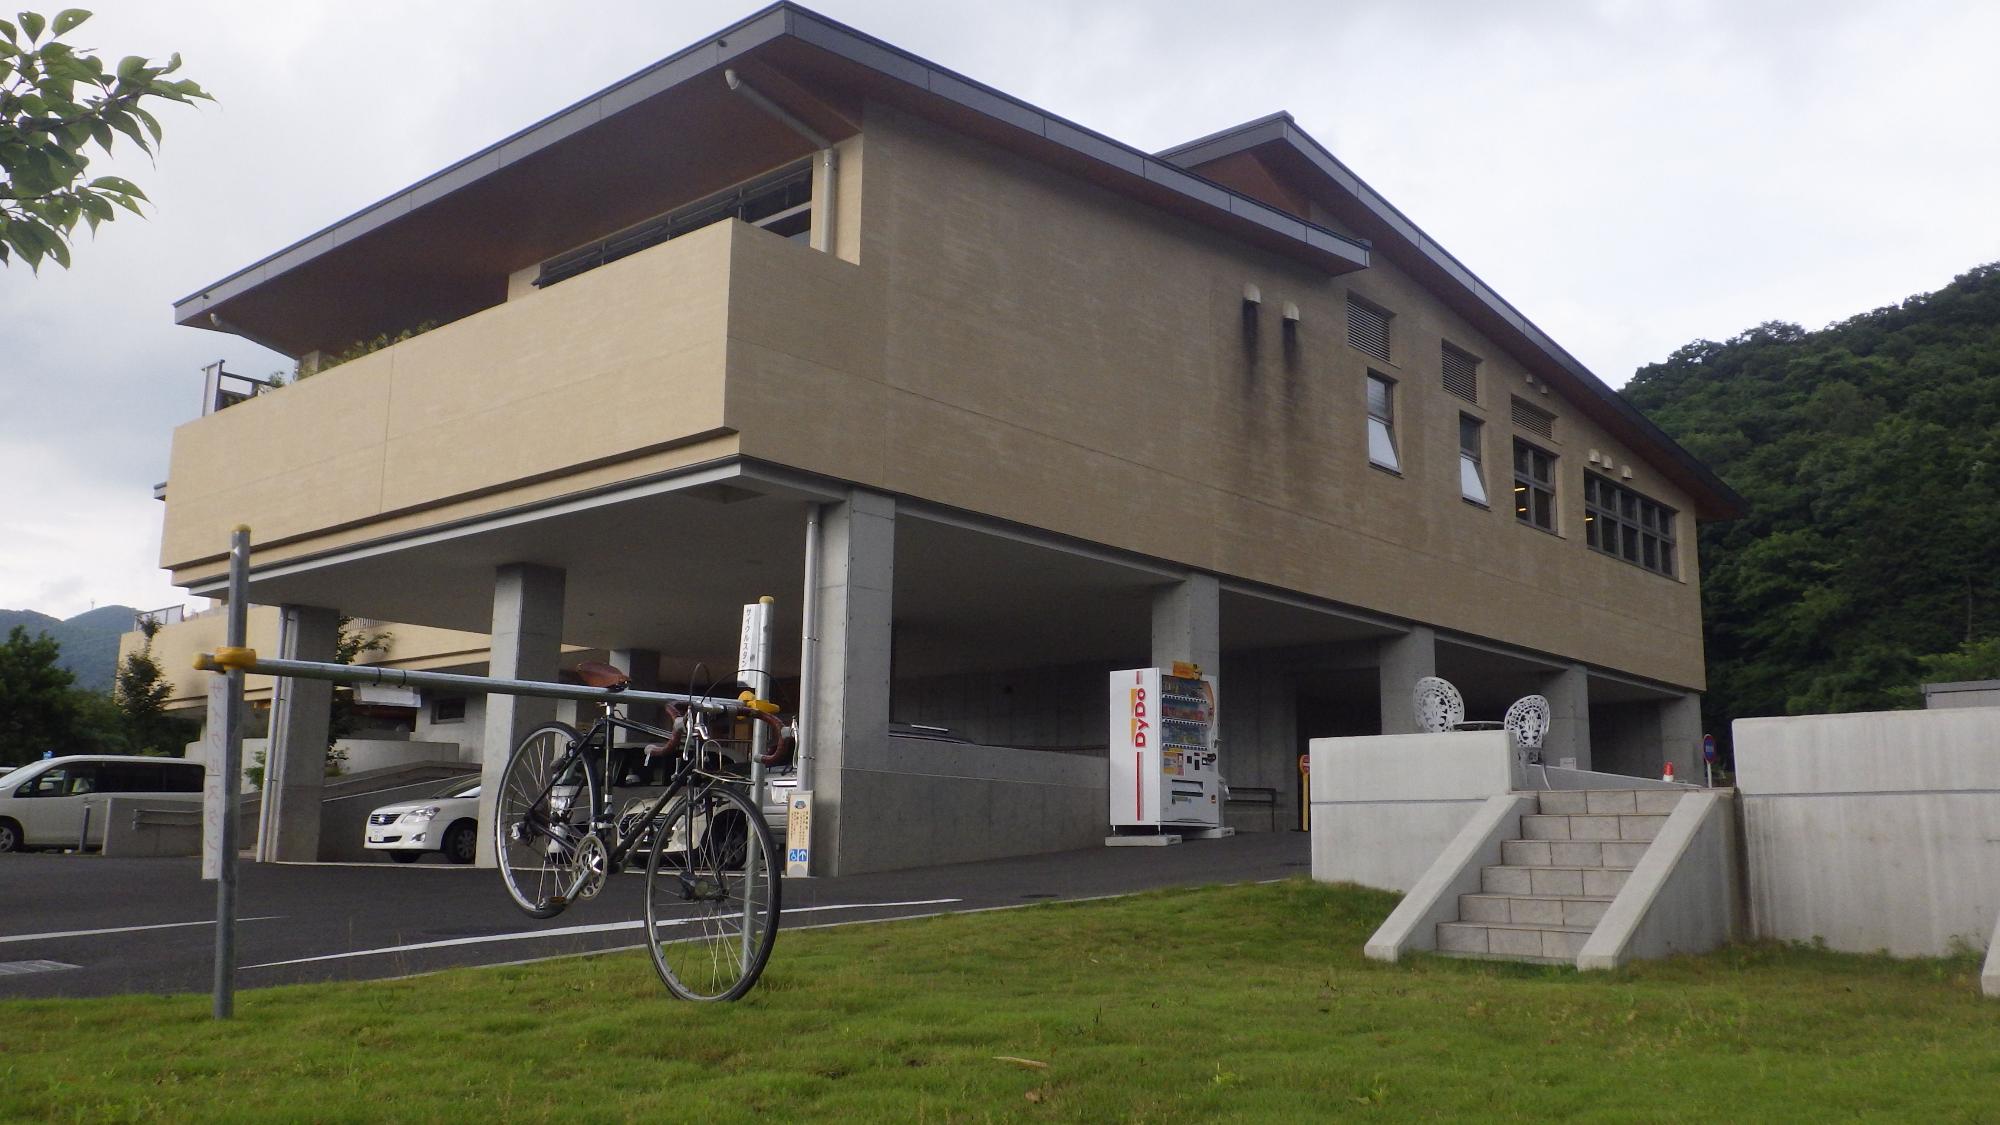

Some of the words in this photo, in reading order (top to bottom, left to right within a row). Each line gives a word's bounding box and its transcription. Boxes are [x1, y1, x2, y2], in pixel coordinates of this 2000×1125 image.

[740, 607, 752, 676] サイクルスタンド
